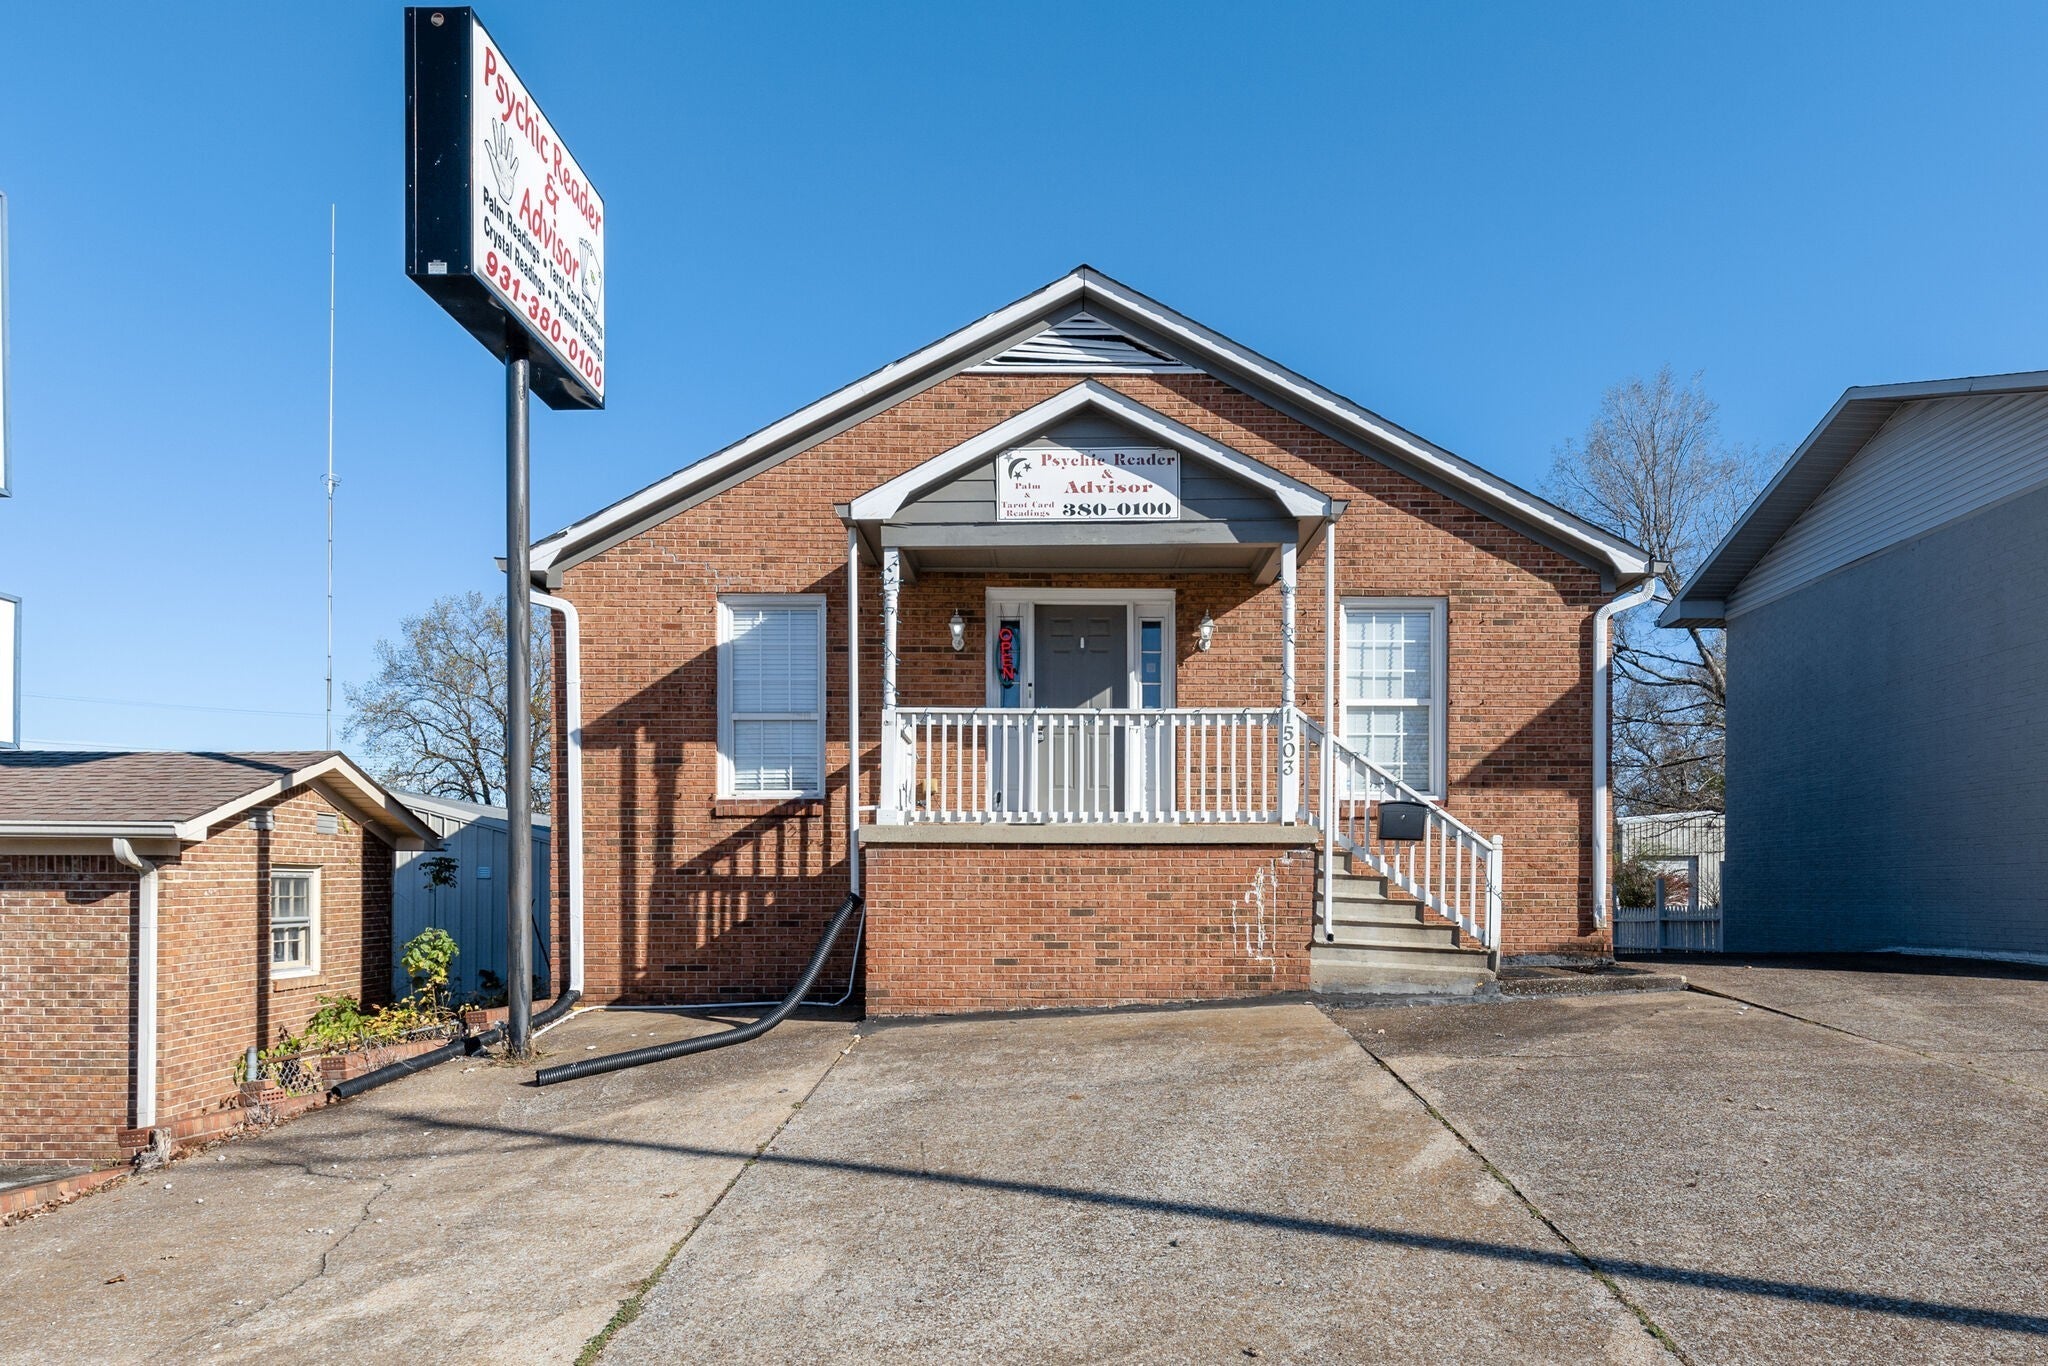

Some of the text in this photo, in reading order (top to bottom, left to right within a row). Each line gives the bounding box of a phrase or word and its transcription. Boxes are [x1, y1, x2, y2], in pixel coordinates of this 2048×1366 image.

[484, 46, 602, 236] Psychic Reader
[544, 172, 560, 214] &
[519, 187, 580, 283] Advisor
[483, 185, 603, 340] Palm Readings Tarot Card Readings
[483, 215, 603, 362] Crystal Readings Pyramid Readings
[485, 251, 602, 388] 931-380-0100
[1015, 482, 1041, 490] Palm
[1041, 453, 1176, 470] Psychic Reader
[1064, 480, 1153, 494] Advisor
[1101, 468, 1114, 479] &
[1062, 502, 1172, 517] 380-0100
[999, 628, 1015, 681] OPEN
[1282, 708, 1296, 777] 1503
